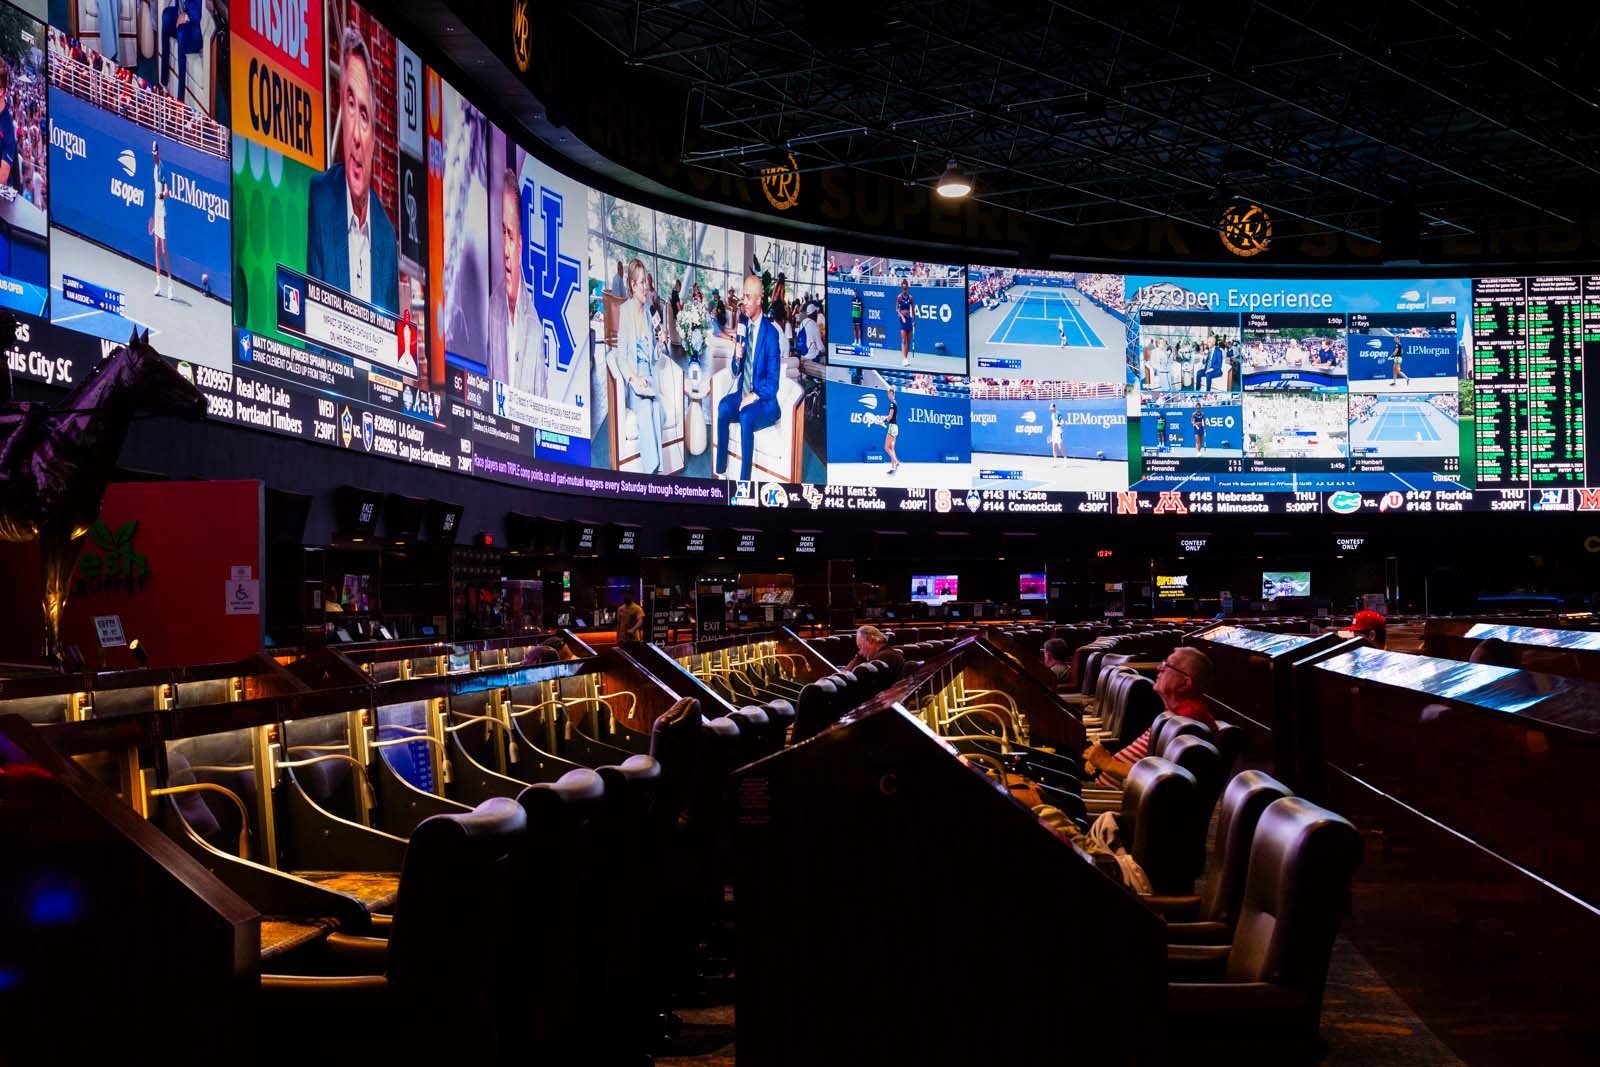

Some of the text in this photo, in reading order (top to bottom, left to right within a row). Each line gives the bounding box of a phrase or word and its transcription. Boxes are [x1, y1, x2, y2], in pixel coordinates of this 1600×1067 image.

[248, 57, 313, 157] CORNER
[168, 171, 230, 224] J.P.Morgan
[308, 283, 321, 301] MLB
[321, 289, 343, 311] CENTRAL
[344, 299, 370, 322] PRESENTED
[1138, 286, 1333, 311] US Open Experience
[866, 326, 877, 338] 84
[252, 334, 266, 350] MATT
[266, 338, 290, 358] CHAPMAN
[327, 356, 344, 375] PLACED
[1406, 345, 1450, 357] J.P.Morgan
[28, 351, 73, 385] City SC
[252, 349, 267, 364] ERNIE
[267, 353, 286, 371] CLEMENT
[286, 358, 301, 376] CALLED
[196, 365, 291, 409] #209957 Real Salt Lake
[318, 398, 335, 419] WED
[236, 401, 302, 434] Portland Timbers
[908, 407, 964, 426] J.P.Morgan
[1065, 412, 1126, 427] J.P.Morgan
[313, 420, 336, 441] 7:30PT
[353, 424, 362, 439] vs.
[374, 414, 425, 446] #209961 LA Galaxy
[460, 438, 472, 454] WED
[374, 436, 451, 469] #209962 San Jose Earthquakes
[474, 453, 485, 468] Race
[485, 456, 498, 473] players
[498, 462, 507, 474] earn
[507, 461, 521, 477] TRIPLE
[520, 467, 531, 482] comp
[531, 468, 544, 483] points
[557, 473, 585, 487] pari-mutuel
[585, 478, 604, 491] wagers
[604, 480, 620, 494] every
[620, 480, 648, 495] Saturday
[648, 483, 673, 497] through
[674, 484, 710, 499] September
[710, 487, 724, 498] 9th.
[788, 492, 801, 502] vs.
[824, 486, 877, 497] #141 Kent St
[907, 487, 925, 498] THU
[982, 490, 1047, 500] #143 NC State
[1086, 490, 1106, 501] THU
[1189, 492, 1264, 502] #145 Nebraska
[1294, 491, 1316, 501] THU
[1406, 490, 1473, 500] #147 Florida
[1500, 489, 1524, 499] THU
[362, 503, 374, 513] RACE
[824, 497, 845, 509] #142
[857, 498, 886, 510] Florida
[899, 500, 928, 511] 4:00PT
[952, 497, 965, 507] vs.
[982, 501, 1063, 512] #144 Connecticut
[1078, 502, 1109, 512] 4:30PT
[1117, 491, 1138, 514] N
[1139, 499, 1152, 508] vs.
[1154, 491, 1187, 514] M
[1189, 503, 1269, 513] #146 Minnesota
[1285, 502, 1319, 513] 5:00PT
[1363, 498, 1378, 508] vs.
[1406, 501, 1463, 511] #148 Utah
[1491, 501, 1526, 511] 5:00PT
[1156, 575, 1189, 587] SUPERBOOK
[703, 621, 721, 631] EXIT
